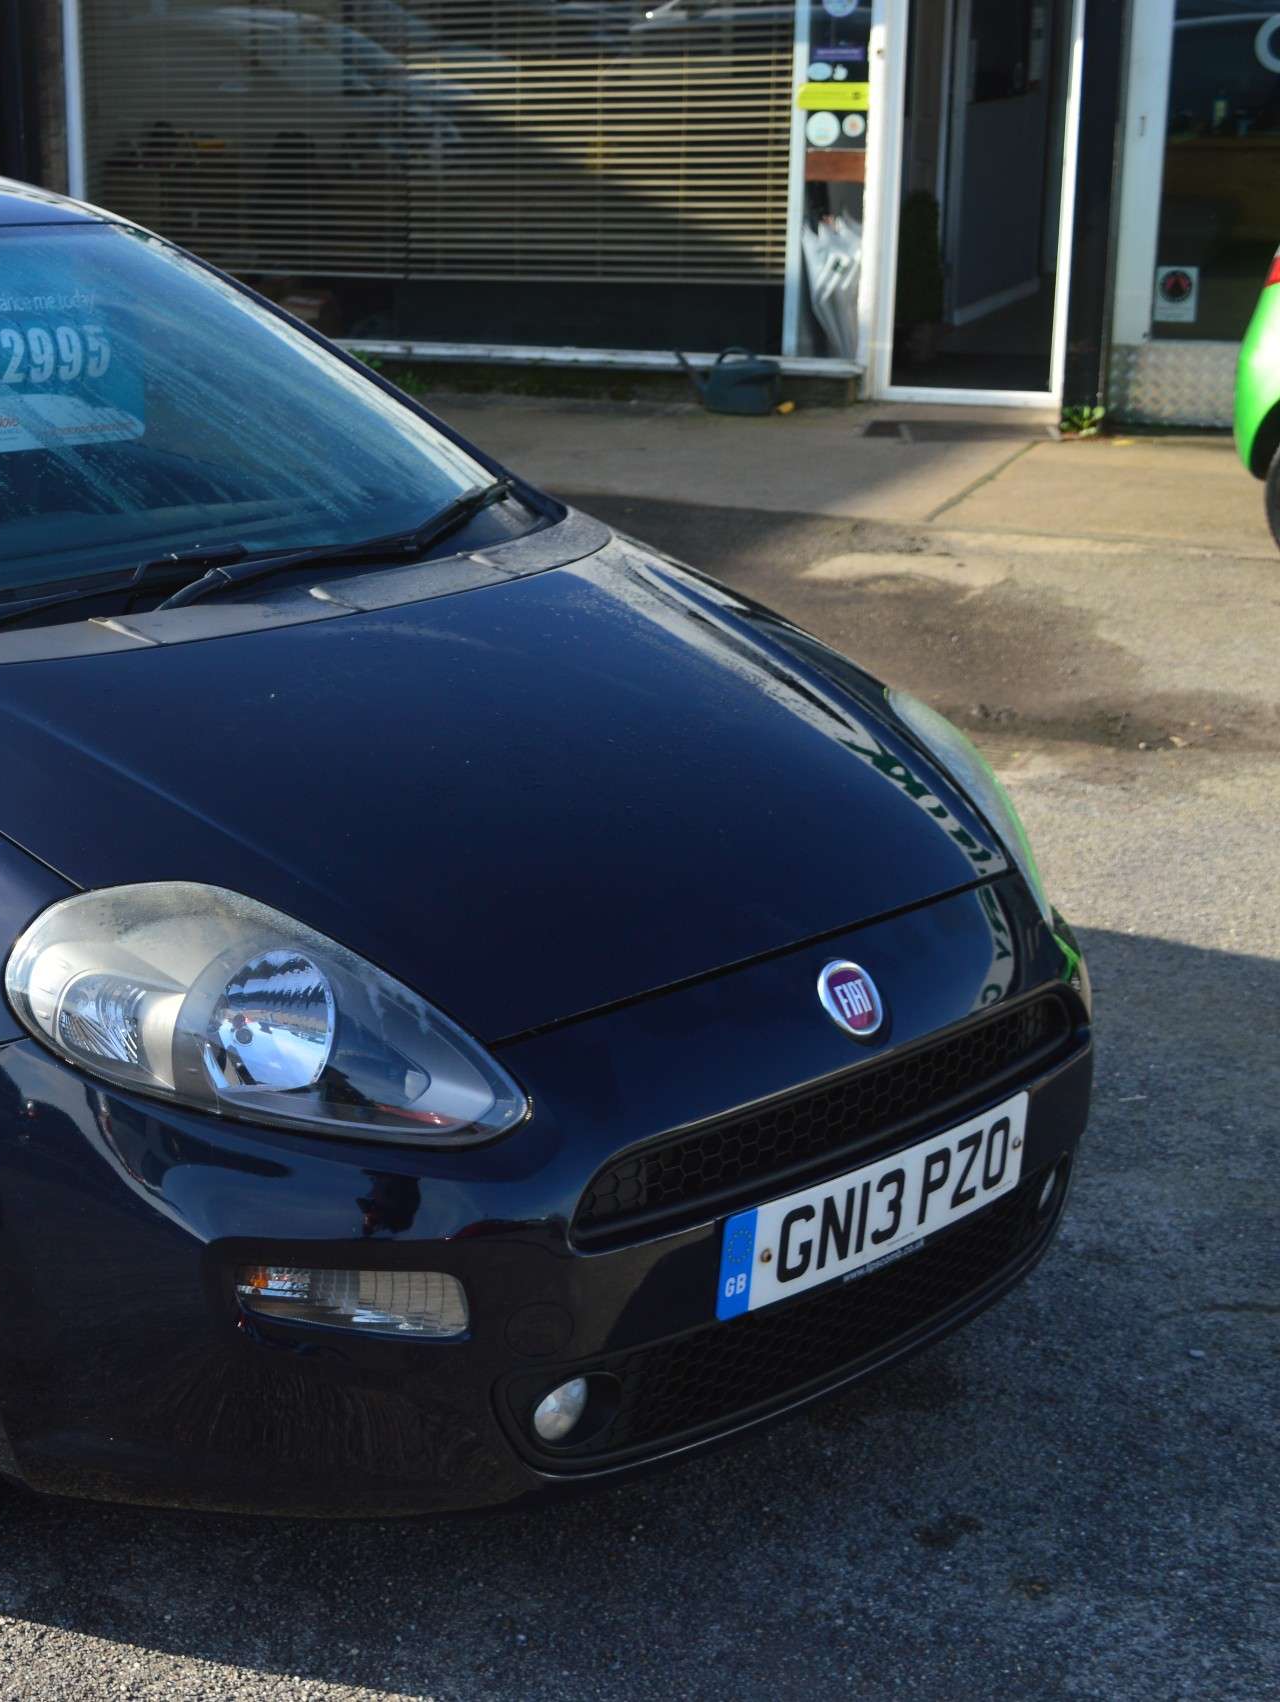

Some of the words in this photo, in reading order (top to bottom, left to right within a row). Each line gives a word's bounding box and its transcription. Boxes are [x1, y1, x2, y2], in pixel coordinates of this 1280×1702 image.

[833, 979, 873, 1018] FIAT
[776, 1167, 906, 1283] GN13
[916, 1116, 1011, 1226] PZO
[725, 1273, 747, 1297] GB
